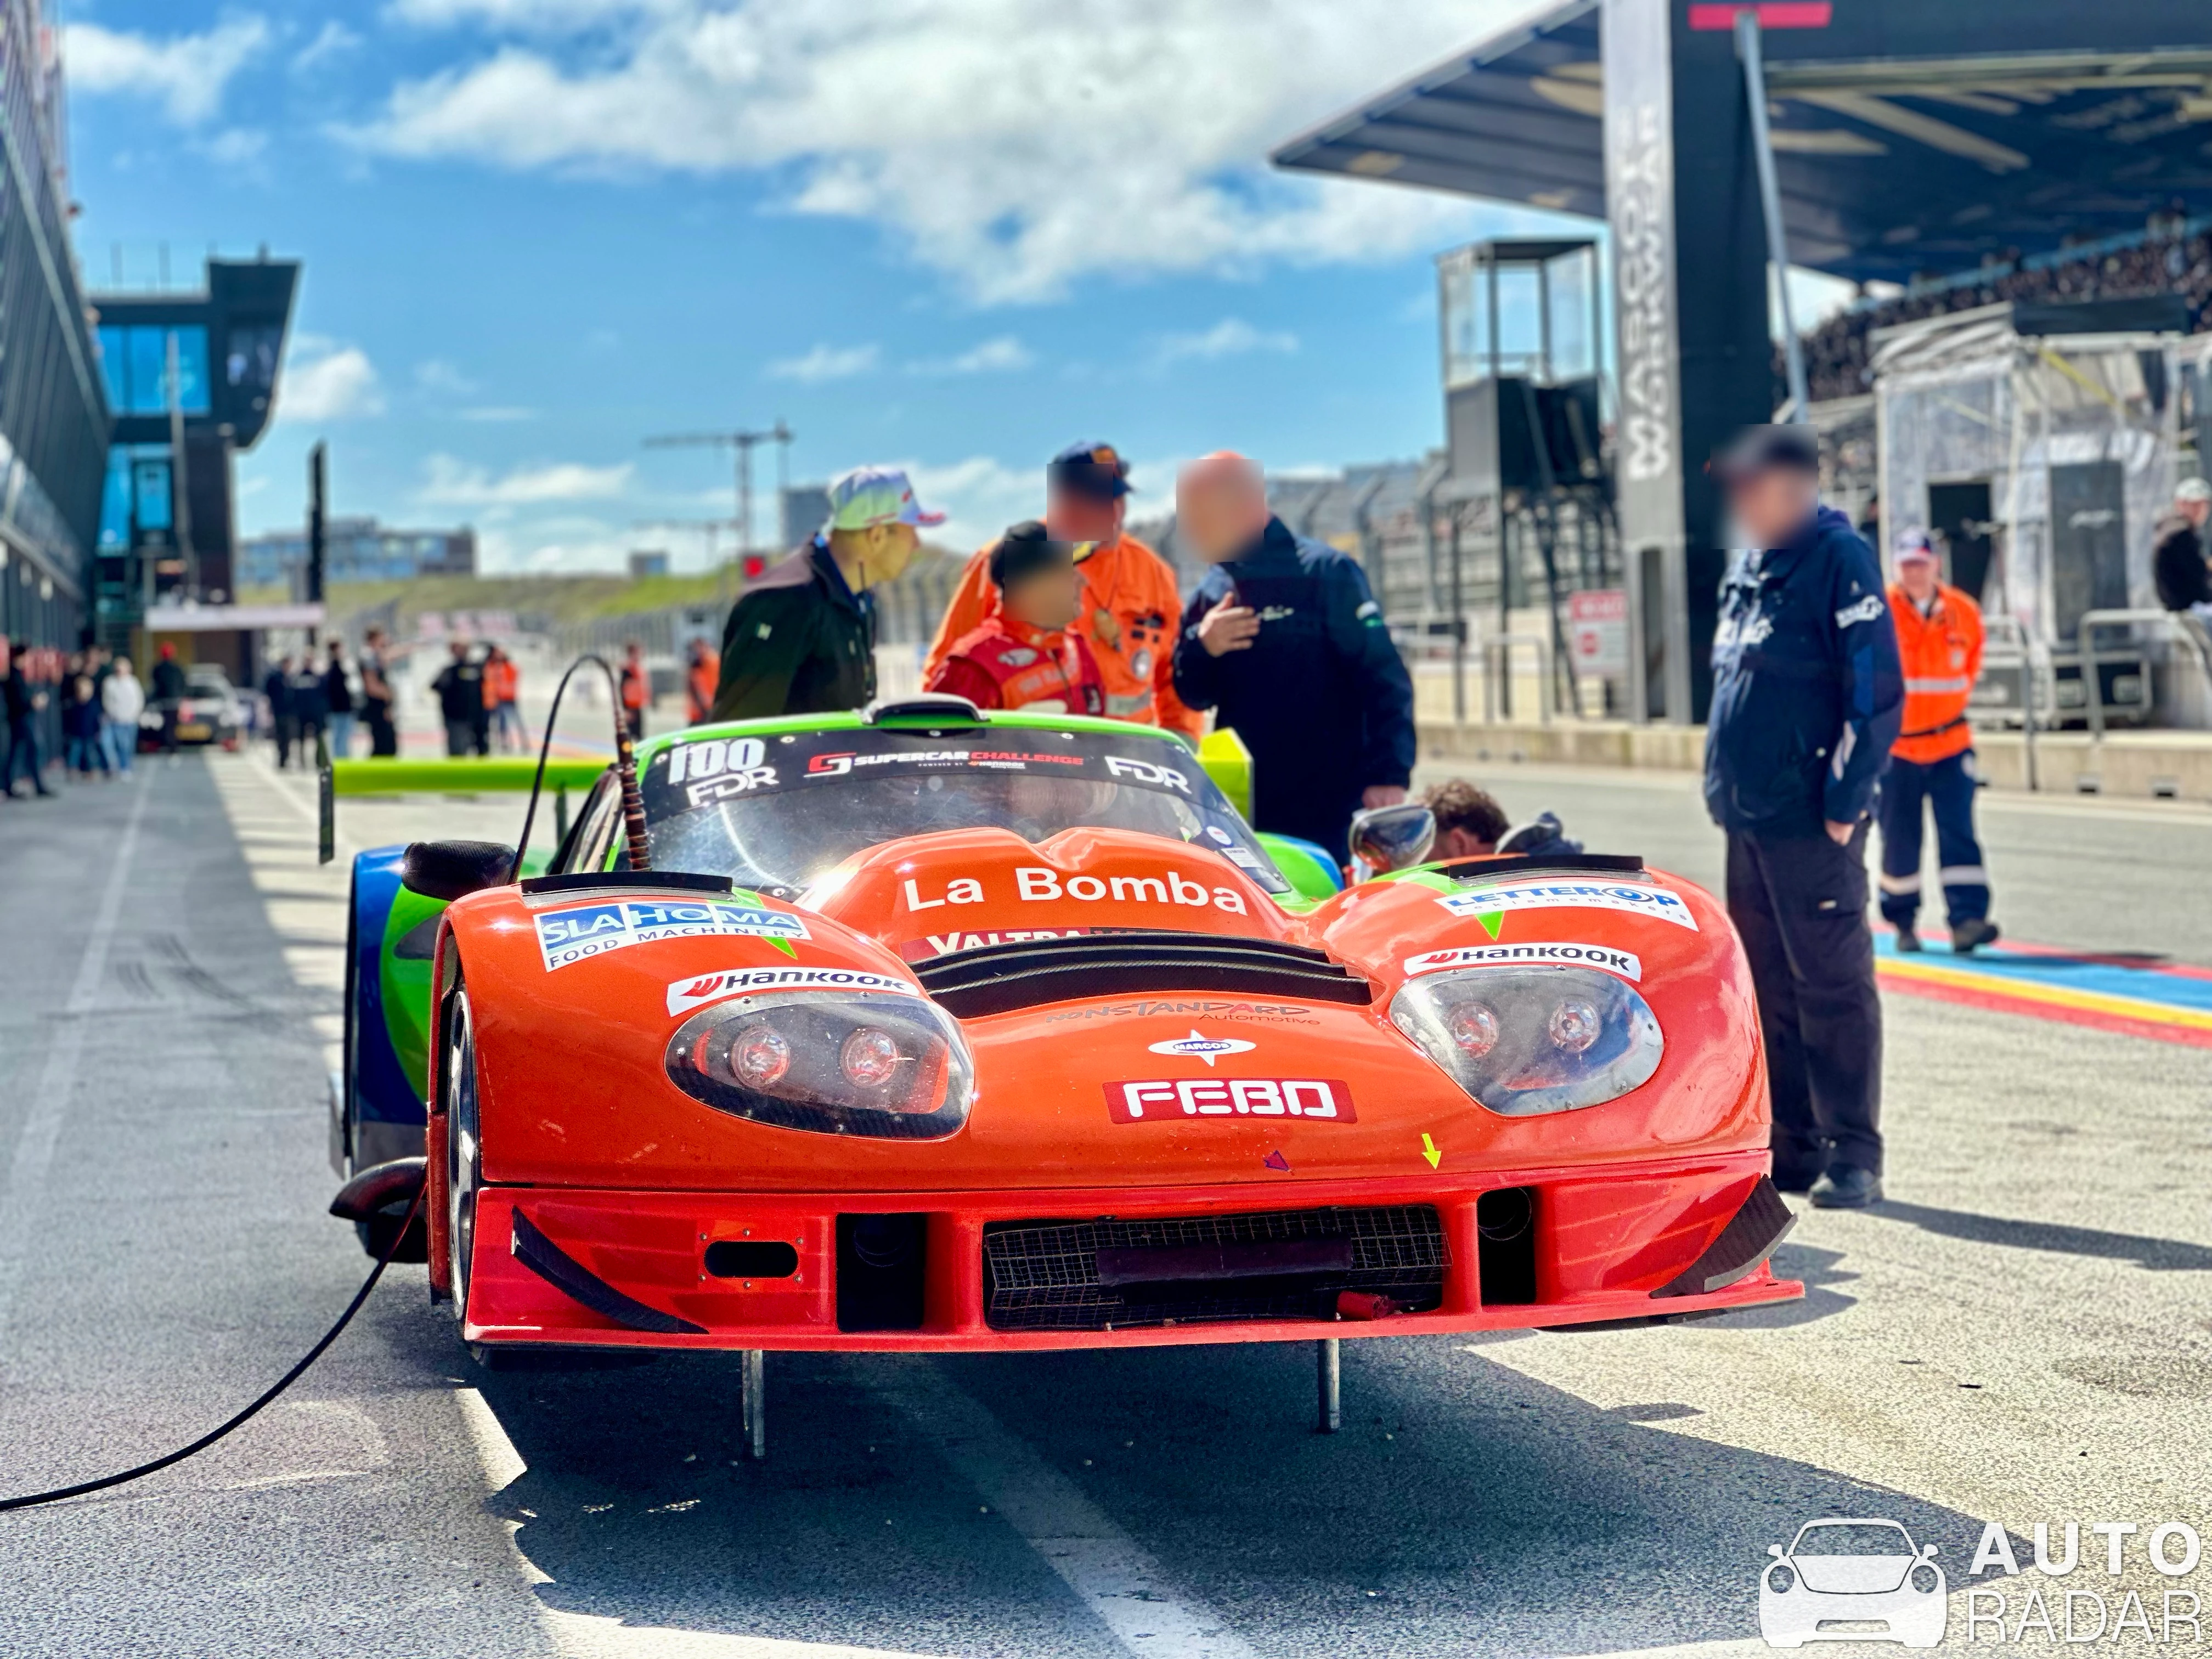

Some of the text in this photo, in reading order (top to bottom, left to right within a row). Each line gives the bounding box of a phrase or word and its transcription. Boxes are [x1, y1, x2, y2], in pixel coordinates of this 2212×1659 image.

[669, 739, 765, 785] 100
[854, 752, 969, 766] SUPERCAR
[971, 752, 1084, 765] CHALLENGE
[1104, 756, 1192, 794] FDR
[687, 766, 780, 806] FDR
[904, 867, 1248, 916] La Bomba
[1447, 886, 1680, 907] LETTEROP
[543, 908, 798, 944] SLAHOMA
[549, 927, 804, 968] FOOD MACHINERY
[1198, 1013, 1321, 1025] Automotive
[1173, 1042, 1230, 1051] MARCOS
[1122, 1080, 1338, 1118] FEBO
